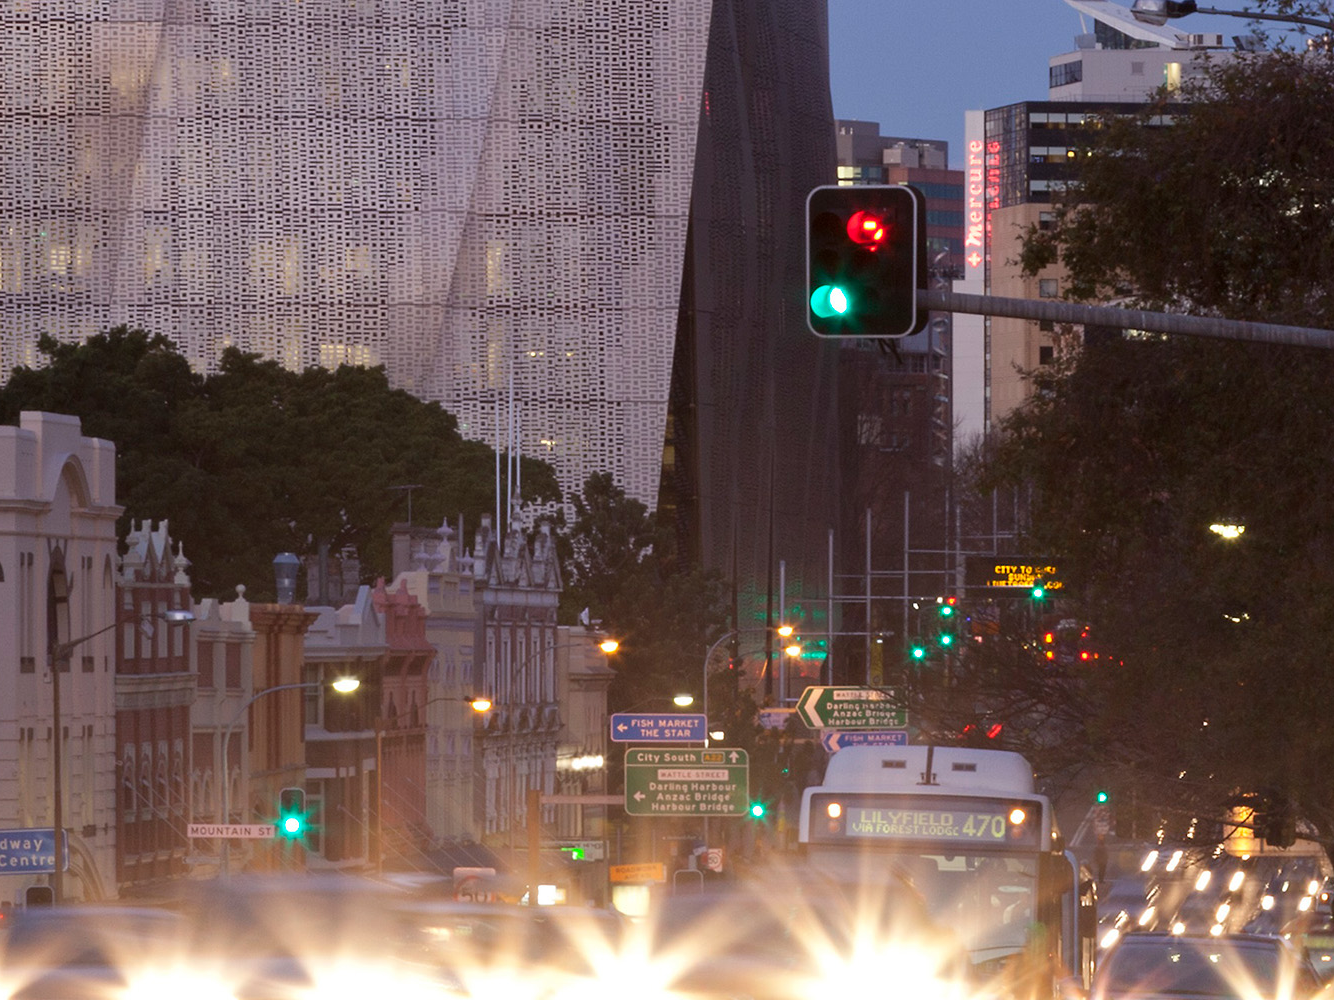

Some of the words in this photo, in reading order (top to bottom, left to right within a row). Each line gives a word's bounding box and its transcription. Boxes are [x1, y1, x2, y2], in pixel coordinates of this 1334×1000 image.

[995, 566, 1017, 575] CITY
[1020, 566, 1032, 575] TO
[827, 702, 860, 711] Darling
[833, 710, 863, 718] Anzac
[631, 719, 654, 727] FISH
[659, 719, 699, 727] MARKET
[828, 718, 867, 726] Harbour
[640, 729, 659, 737] THE
[665, 729, 691, 737] STAR
[637, 753, 660, 763] City
[664, 753, 697, 762] South
[704, 754, 723, 762] A22
[649, 782, 688, 792] Darling
[691, 782, 736, 791] Harbour
[656, 793, 691, 801] Anzac
[695, 793, 730, 802] Bridge
[651, 803, 697, 811] Harbour
[700, 803, 735, 812] Bridge
[860, 810, 953, 826] LILYFIELD
[191, 826, 253, 836] MOUNTAIN
[259, 826, 272, 836] ST
[852, 823, 874, 833] VIA
[876, 824, 919, 834] FOREST
[962, 815, 1005, 838] 470
